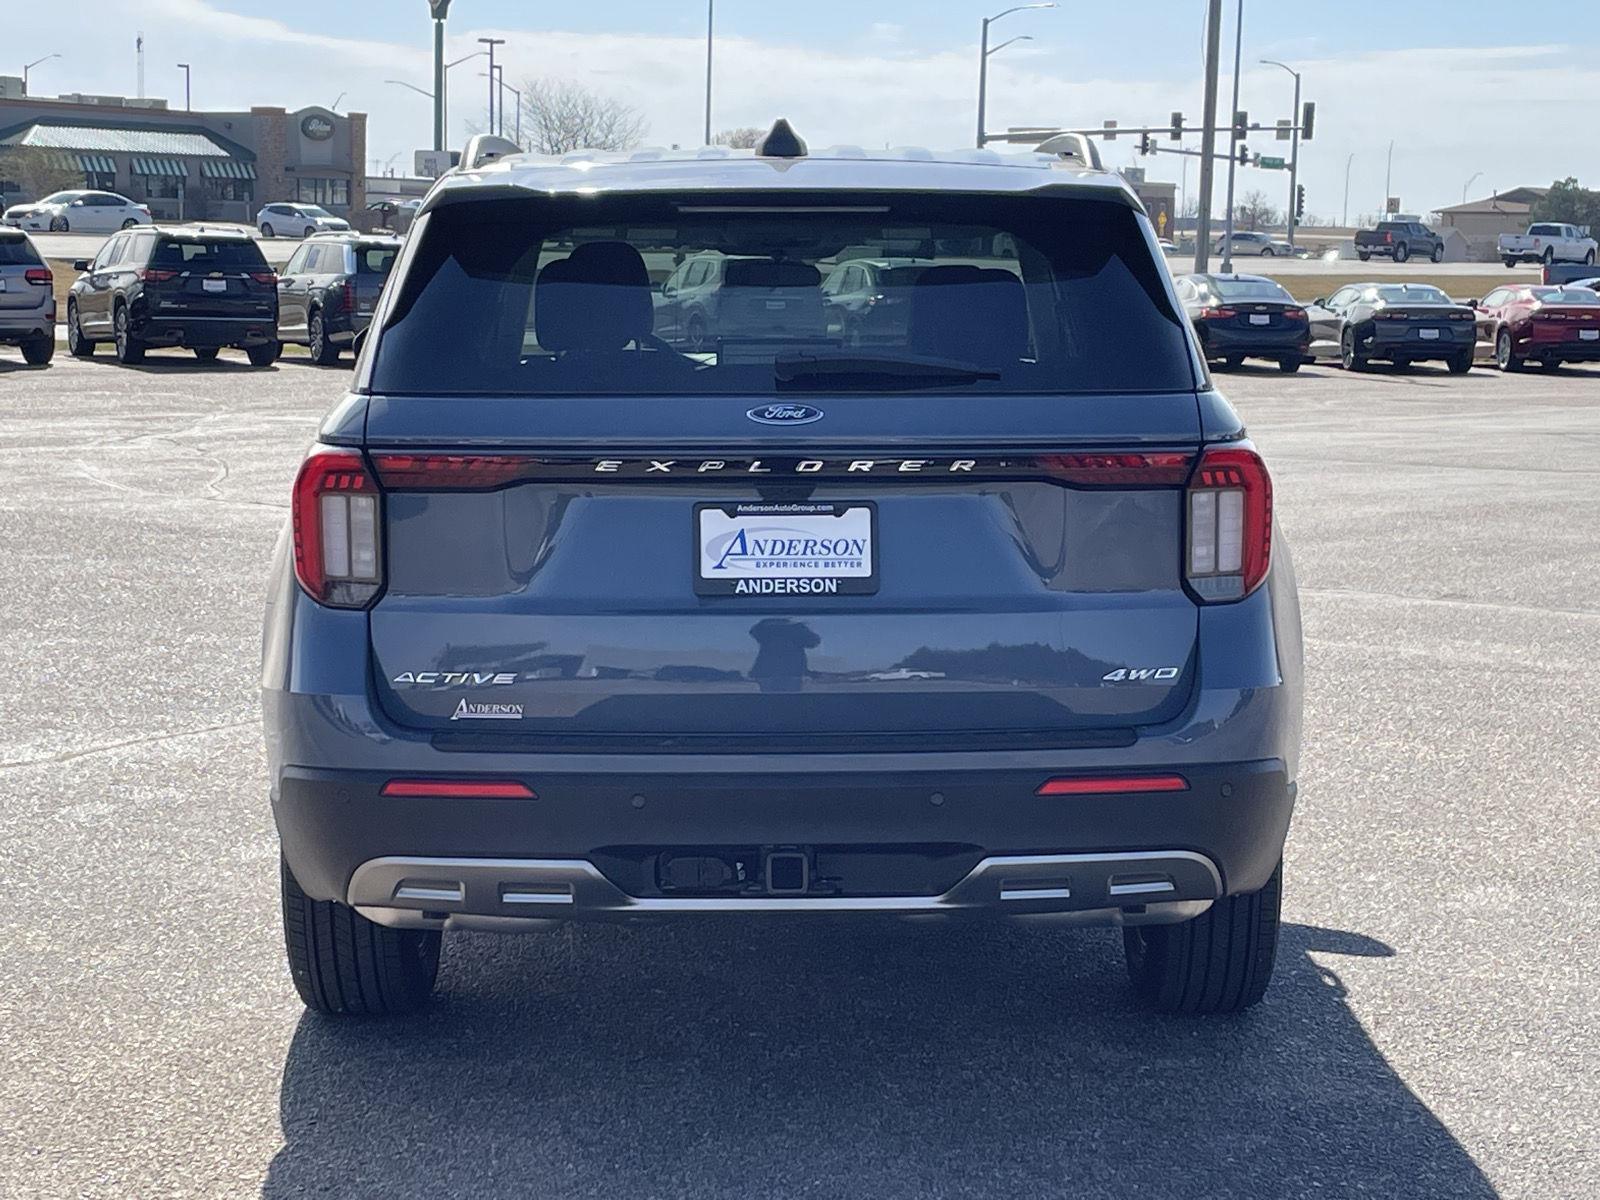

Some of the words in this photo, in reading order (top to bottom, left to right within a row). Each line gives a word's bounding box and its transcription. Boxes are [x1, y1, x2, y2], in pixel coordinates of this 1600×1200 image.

[765, 406, 806, 418] Ford
[595, 460, 976, 473] EXPLORER
[737, 504, 834, 513] AndersonAutoGroup.com
[712, 528, 867, 569] ANDERSON
[735, 578, 837, 594] ANDERSON
[393, 672, 518, 684] ACTIVE
[1103, 667, 1178, 681] 4WD
[450, 698, 524, 720] ANDERSON
